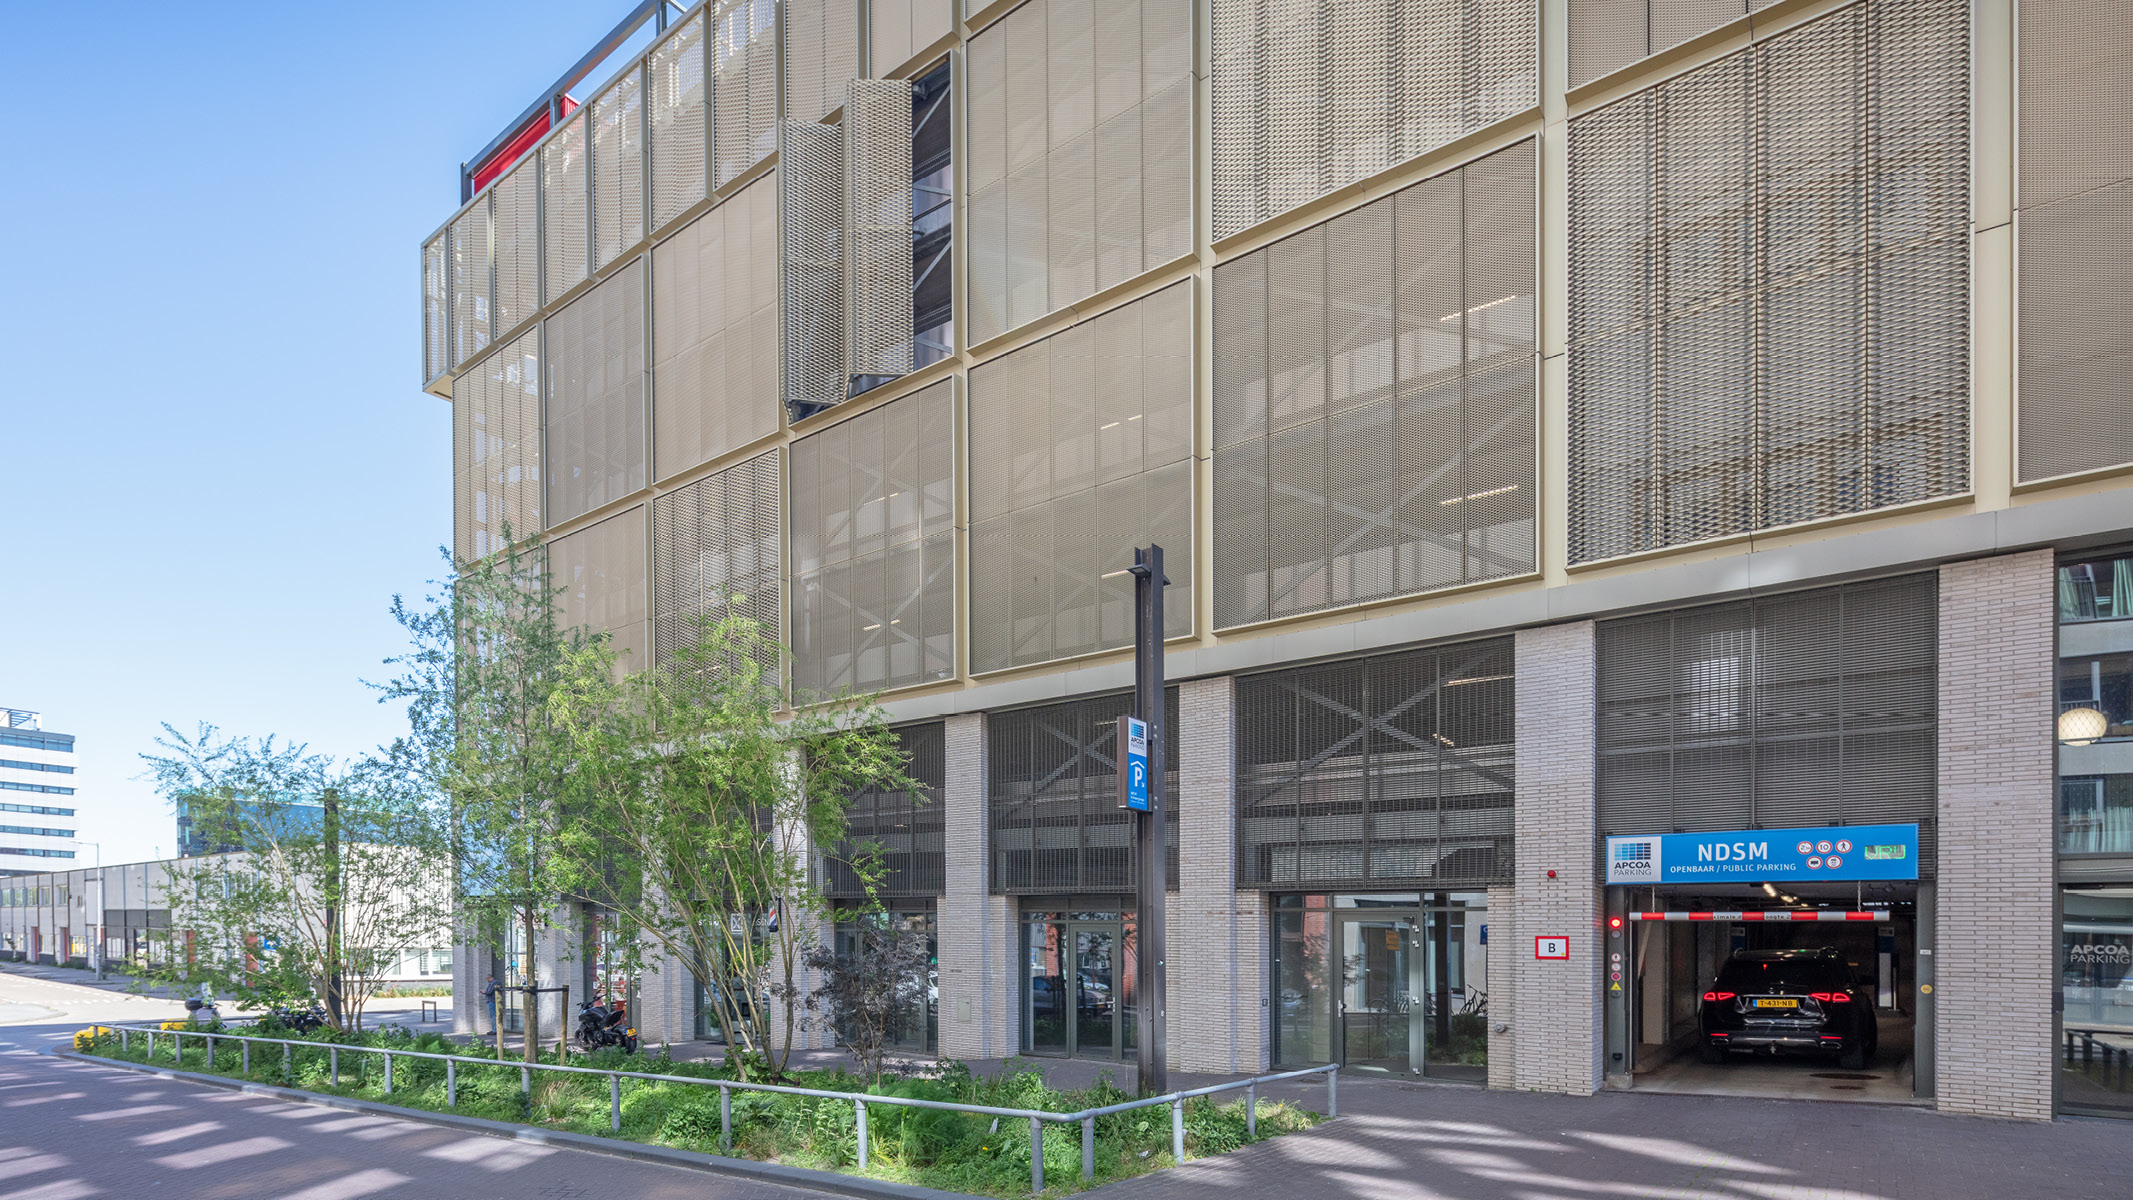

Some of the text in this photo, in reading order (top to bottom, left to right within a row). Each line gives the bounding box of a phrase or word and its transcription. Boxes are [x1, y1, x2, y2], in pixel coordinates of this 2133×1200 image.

[1134, 766, 1143, 787] P
[1698, 842, 1767, 861] NDSM
[1614, 861, 1651, 869] APCOA
[1670, 865, 1714, 873] OPENBAAR
[1723, 864, 1754, 872] PUBLIC
[1757, 863, 1796, 871] PARKING
[1614, 868, 1652, 876] PARKING
[1548, 942, 1556, 953] B
[2071, 944, 2130, 955] APCOA
[2070, 955, 2130, 964] PARKING
